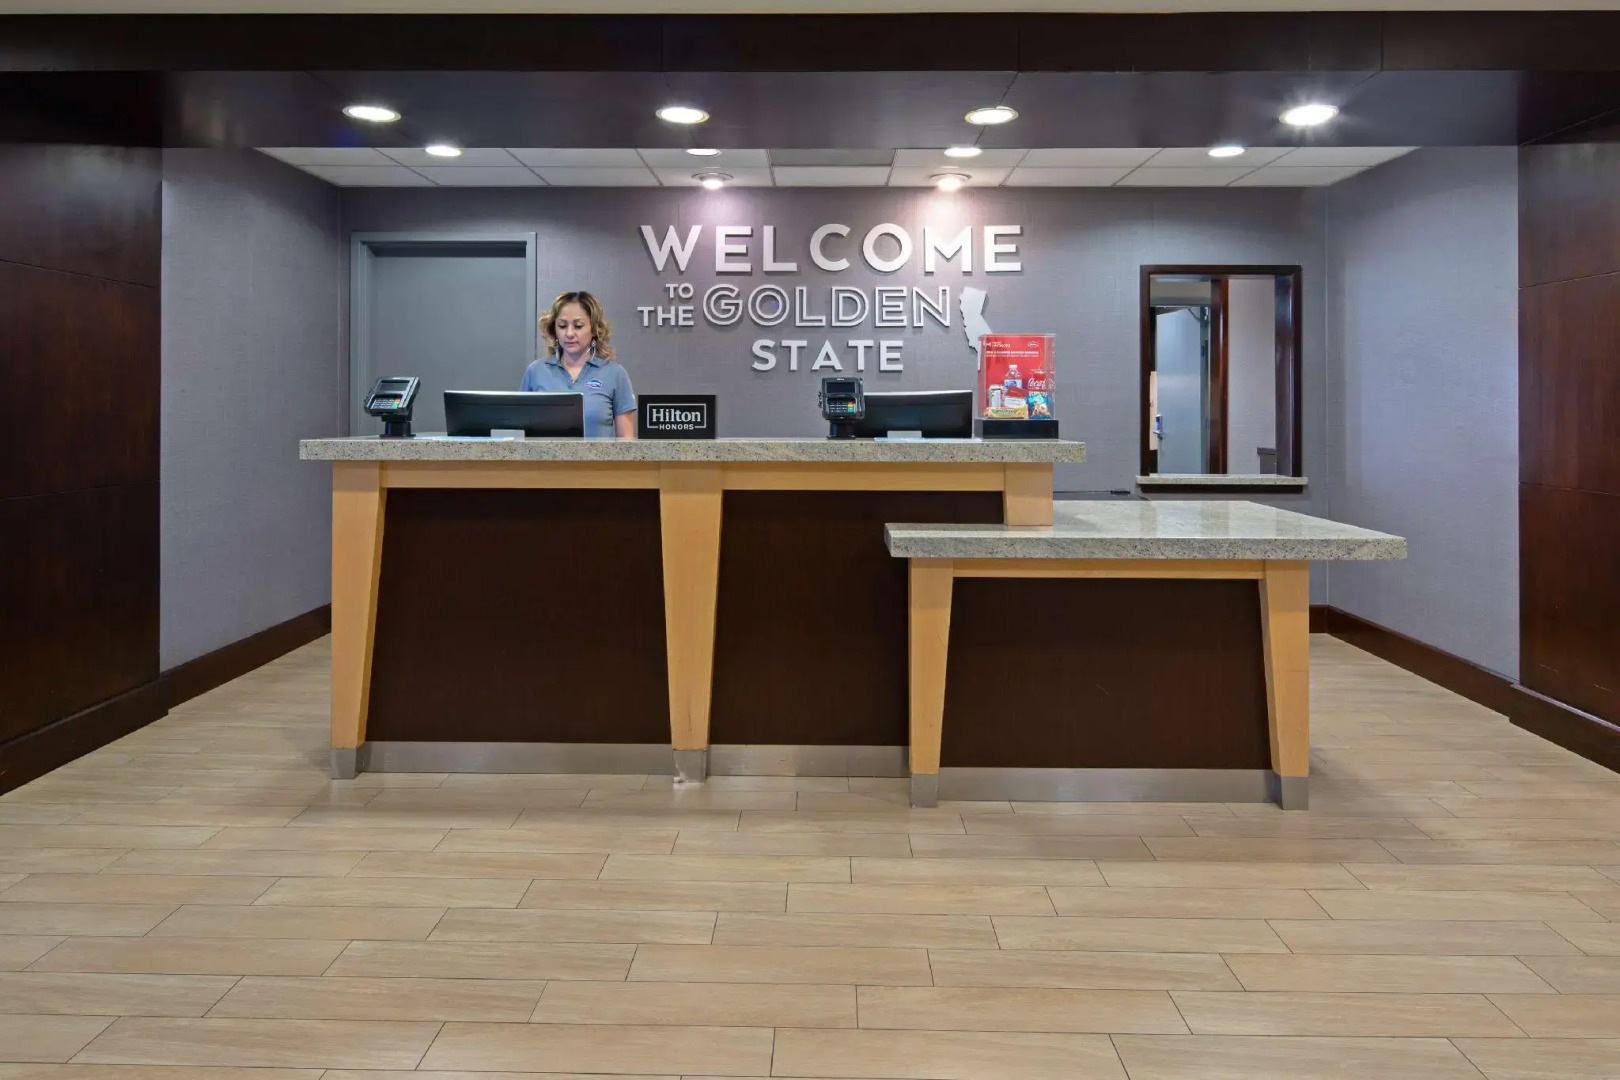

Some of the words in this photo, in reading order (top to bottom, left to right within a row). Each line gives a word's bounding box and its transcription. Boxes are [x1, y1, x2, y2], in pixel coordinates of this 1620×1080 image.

[640, 223, 1022, 272] WELCOME
[637, 306, 694, 327] THE
[703, 284, 951, 327] GOLDEN
[666, 283, 693, 298] TO
[752, 339, 904, 371] STATE
[652, 409, 701, 423] Hilton
